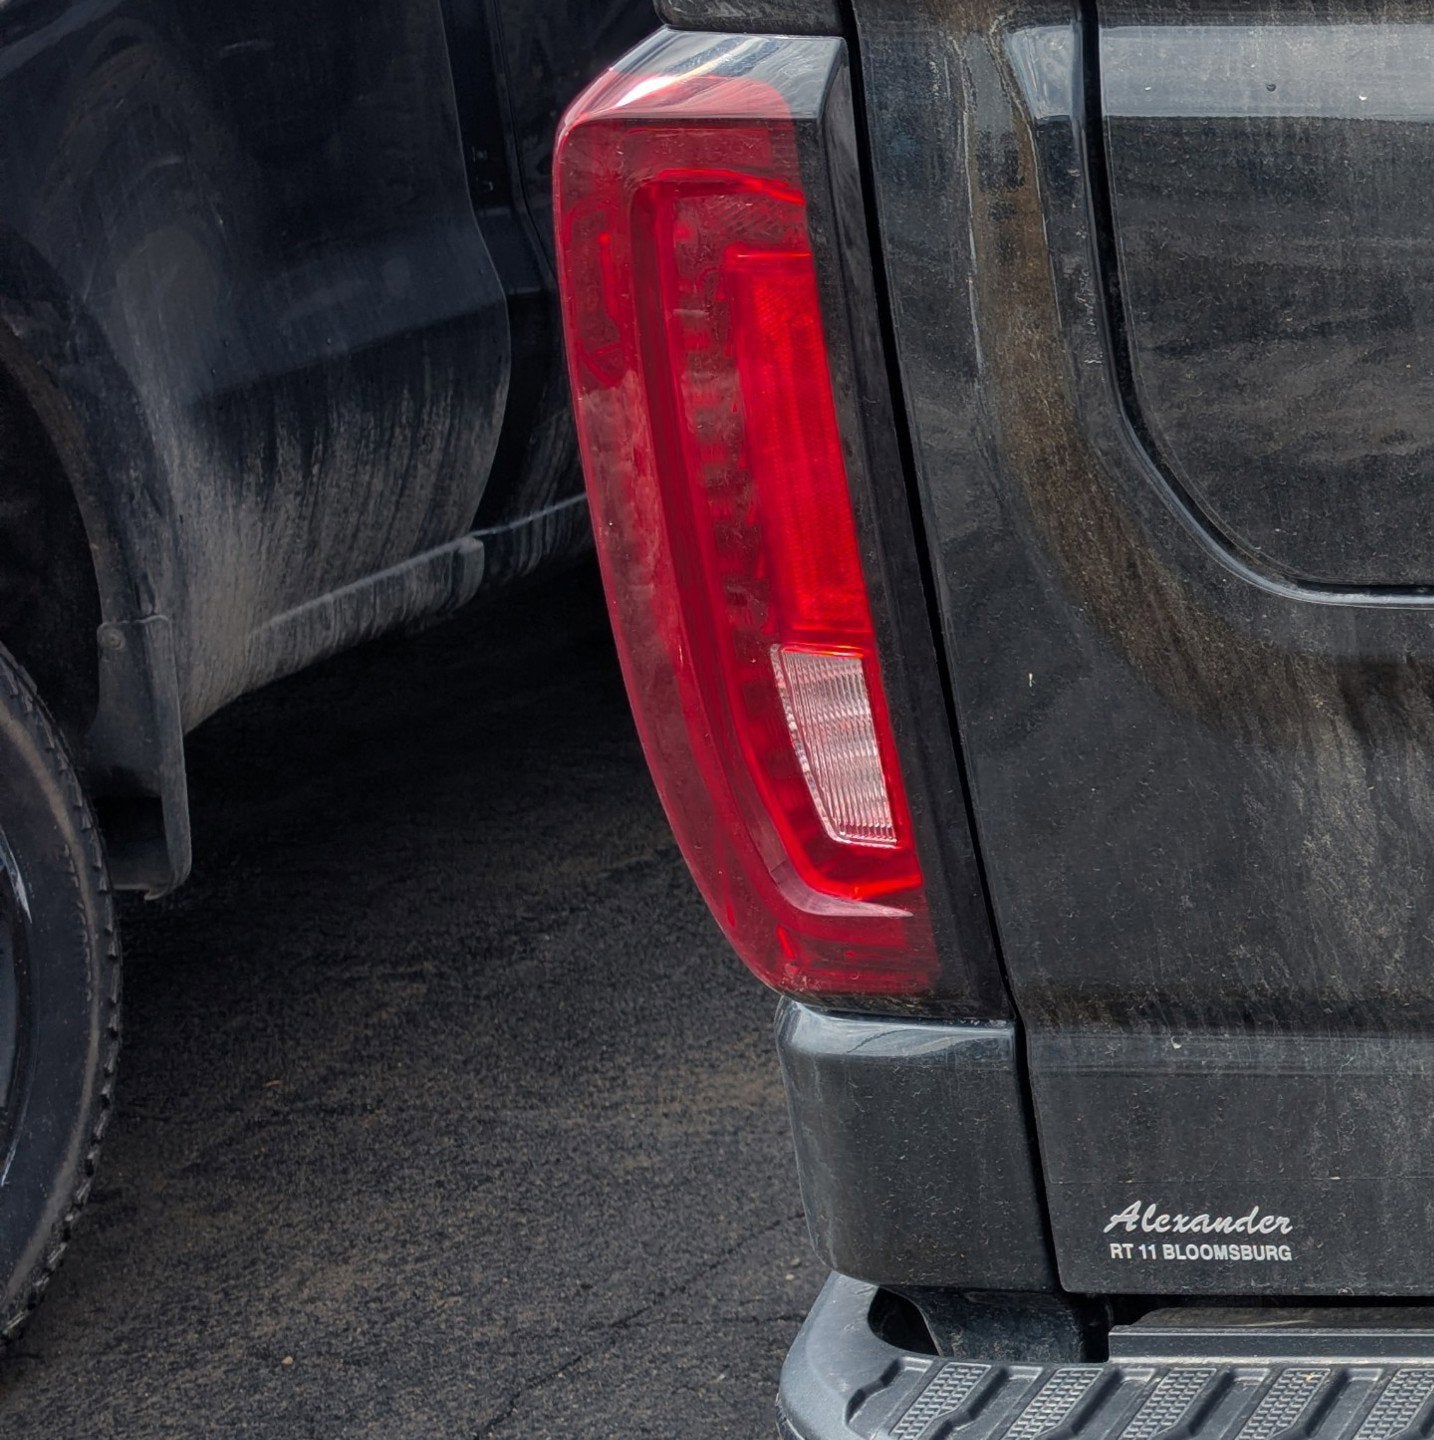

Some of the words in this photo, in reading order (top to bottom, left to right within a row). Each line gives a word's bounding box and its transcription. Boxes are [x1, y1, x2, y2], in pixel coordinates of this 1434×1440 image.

[1102, 1200, 1294, 1235] Alexander
[1109, 1243, 1134, 1260] RT
[1139, 1244, 1158, 1260] 11
[1162, 1243, 1293, 1262] BLOOMSBURG
